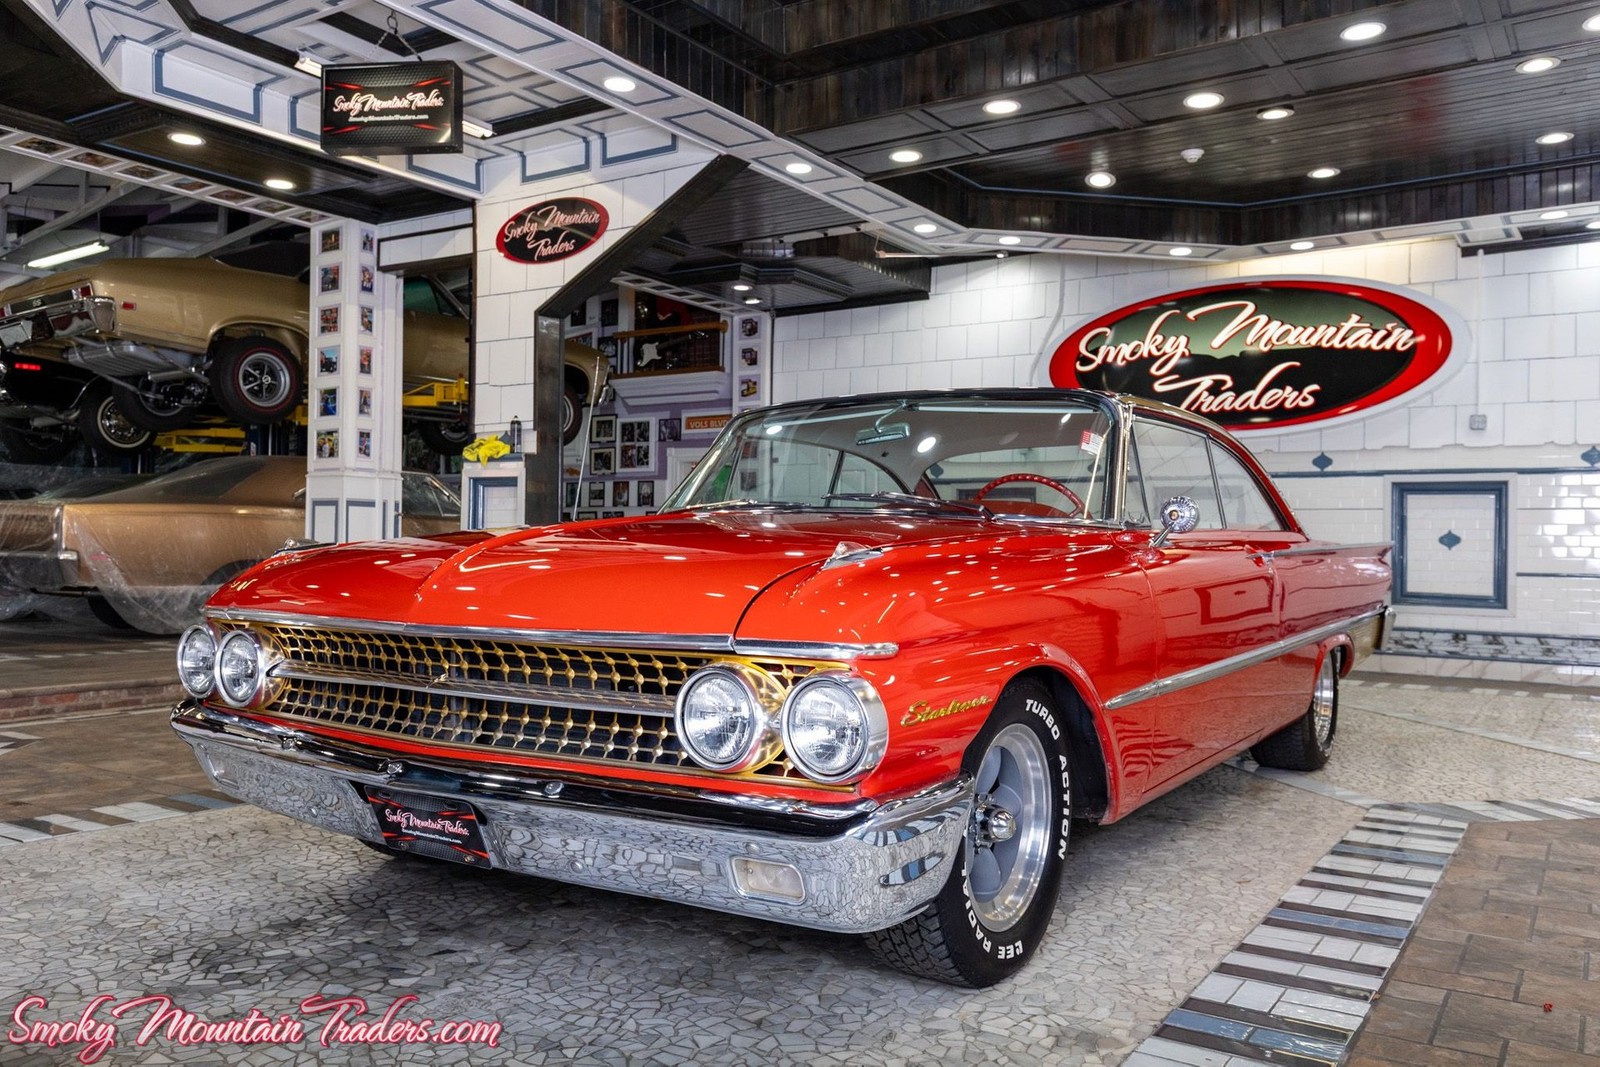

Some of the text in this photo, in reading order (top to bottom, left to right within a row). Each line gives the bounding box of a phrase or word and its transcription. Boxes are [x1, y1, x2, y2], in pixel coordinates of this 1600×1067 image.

[332, 89, 445, 116] Smoky Mountain Traders
[504, 205, 600, 243] Smoky Mountain
[527, 230, 577, 261] Traders
[32, 299, 42, 307] SS
[1075, 300, 1417, 376] Smoky Mountain
[1152, 361, 1322, 413] Traders
[689, 420, 709, 429] VOLS
[1025, 699, 1071, 860] TURBO ACTION
[384, 808, 470, 836] Smoky Mountain Traders
[997, 940, 1024, 960] LEE
